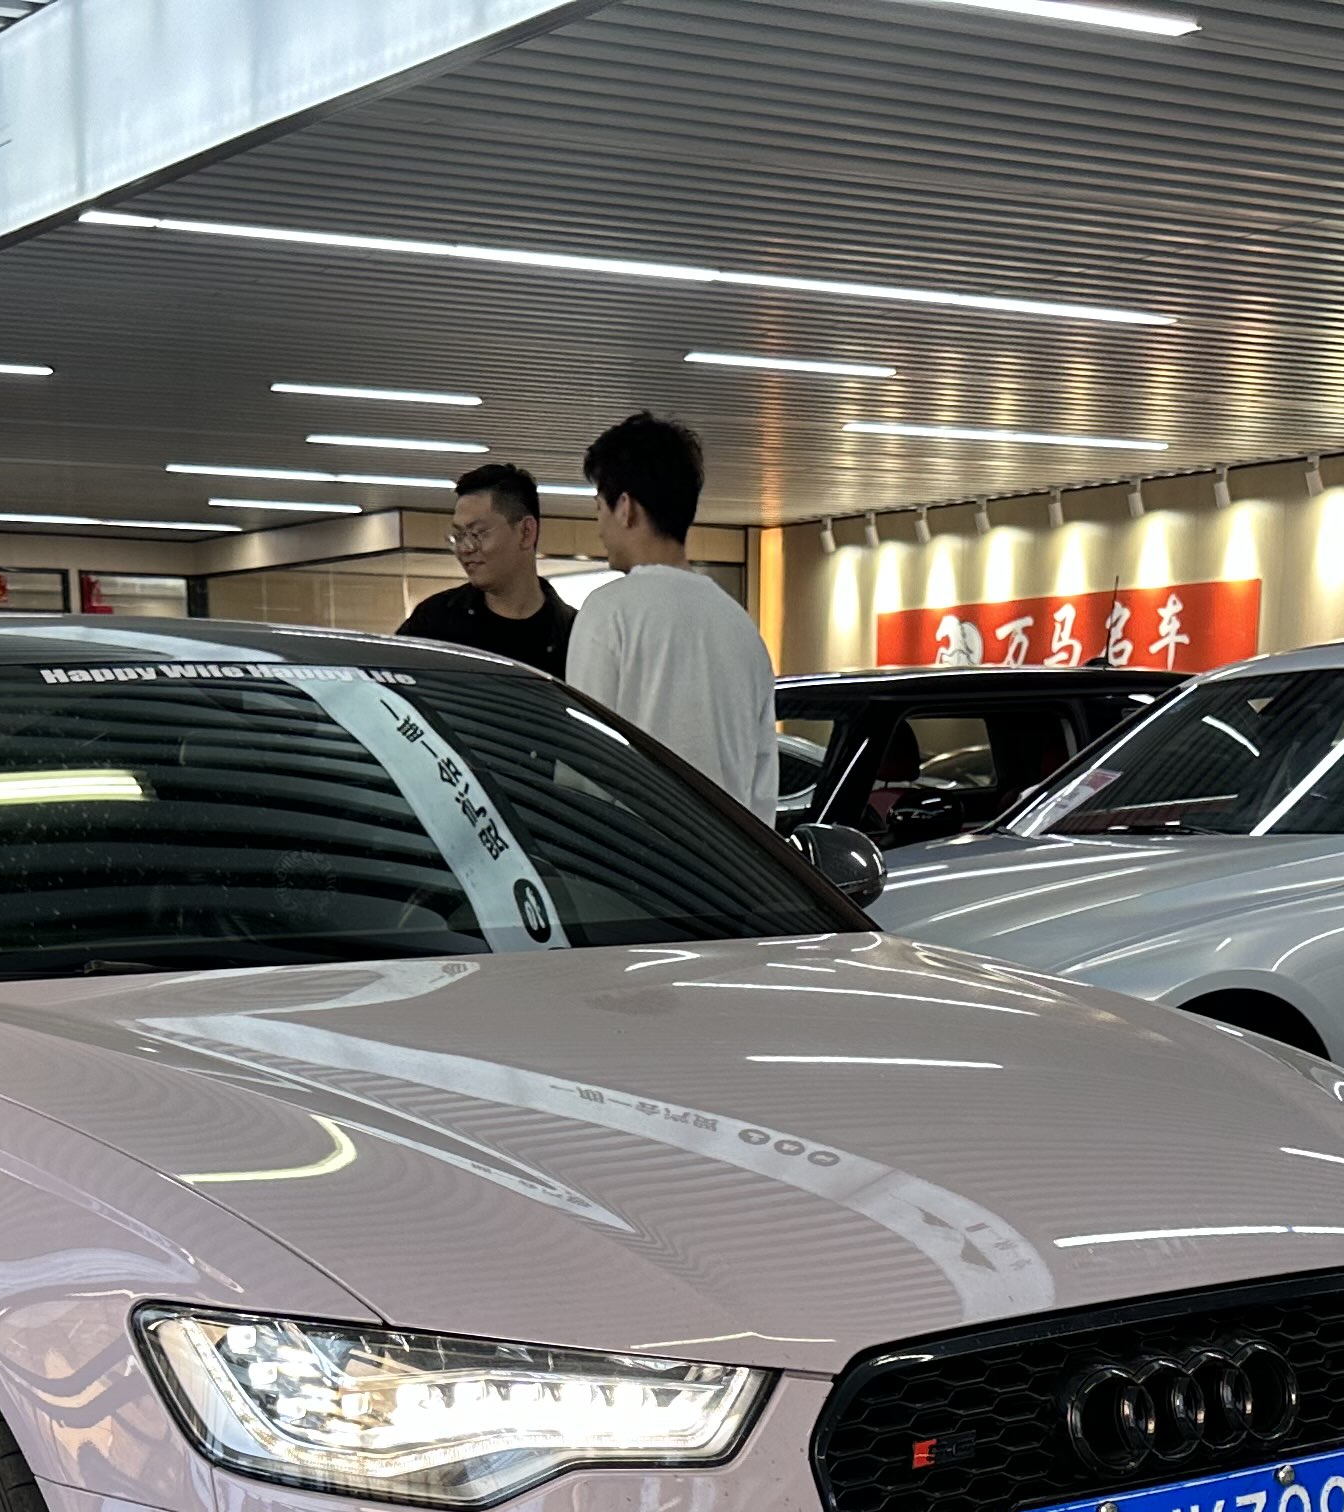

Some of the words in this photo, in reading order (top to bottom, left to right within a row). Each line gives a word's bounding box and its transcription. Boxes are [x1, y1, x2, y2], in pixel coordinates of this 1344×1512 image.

[995, 593, 1190, 671] 万马名车
[40, 667, 156, 684] Happy
[158, 664, 245, 679] Wife
[246, 665, 355, 681] Happy
[355, 669, 417, 686] Life
